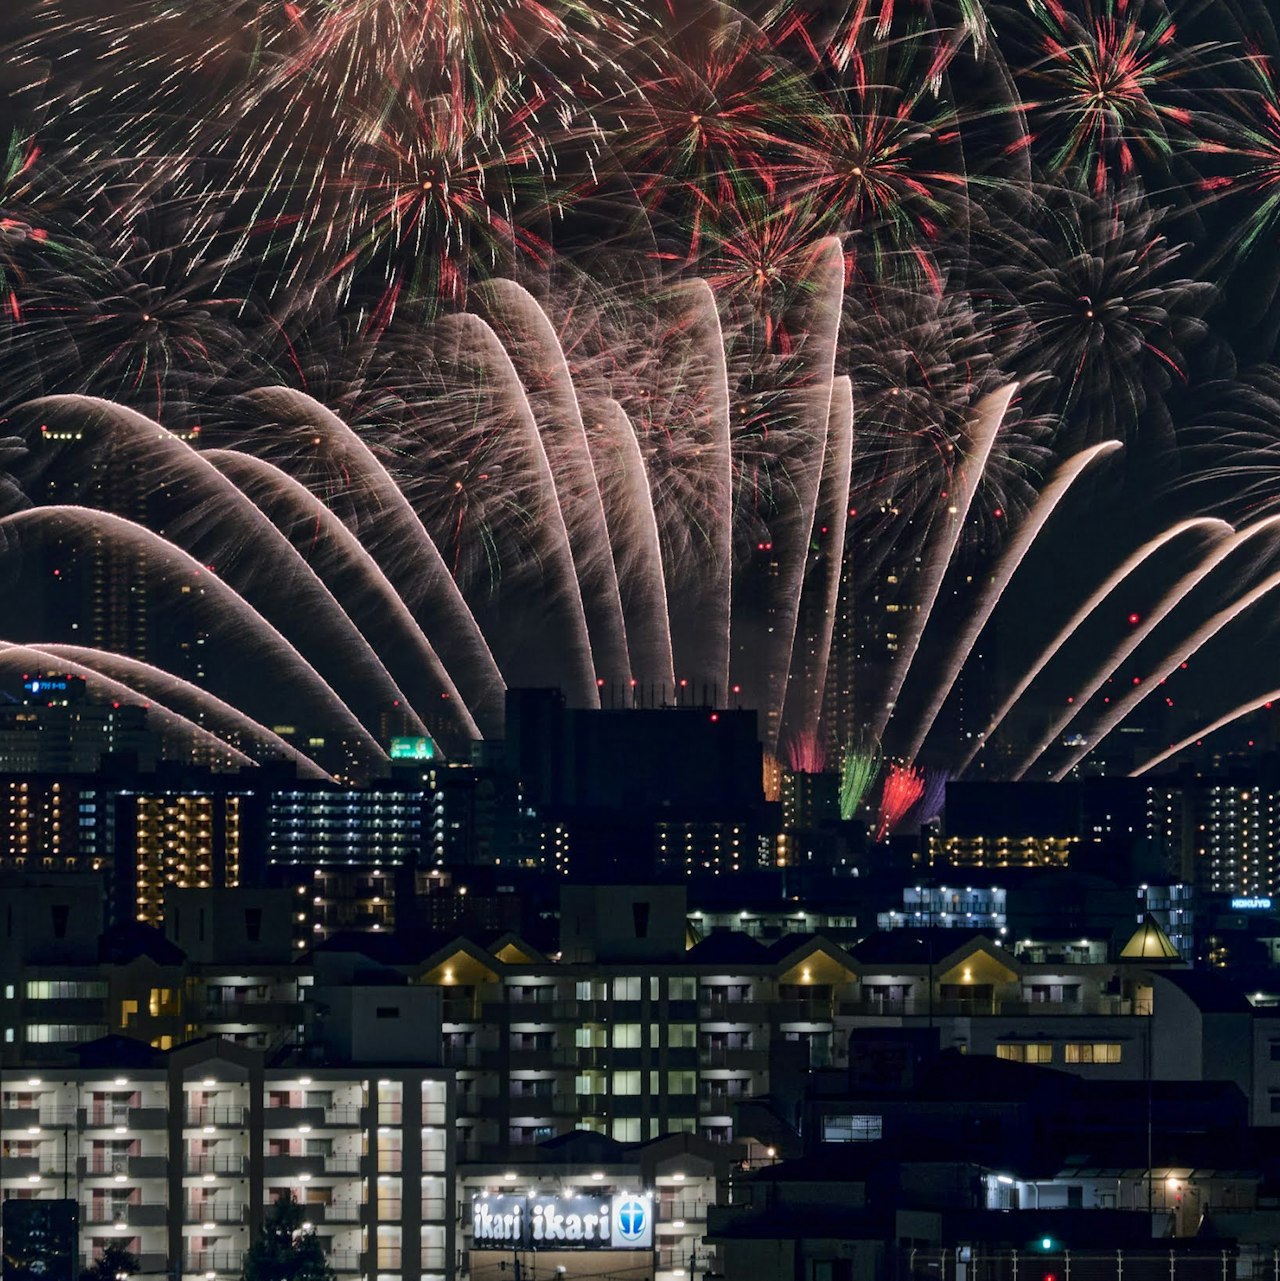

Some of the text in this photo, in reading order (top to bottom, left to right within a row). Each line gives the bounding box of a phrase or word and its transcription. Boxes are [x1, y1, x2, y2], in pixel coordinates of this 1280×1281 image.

[1232, 898, 1271, 908] KOKUYO
[474, 1203, 521, 1240] ikari
[532, 1204, 611, 1241] ikari
